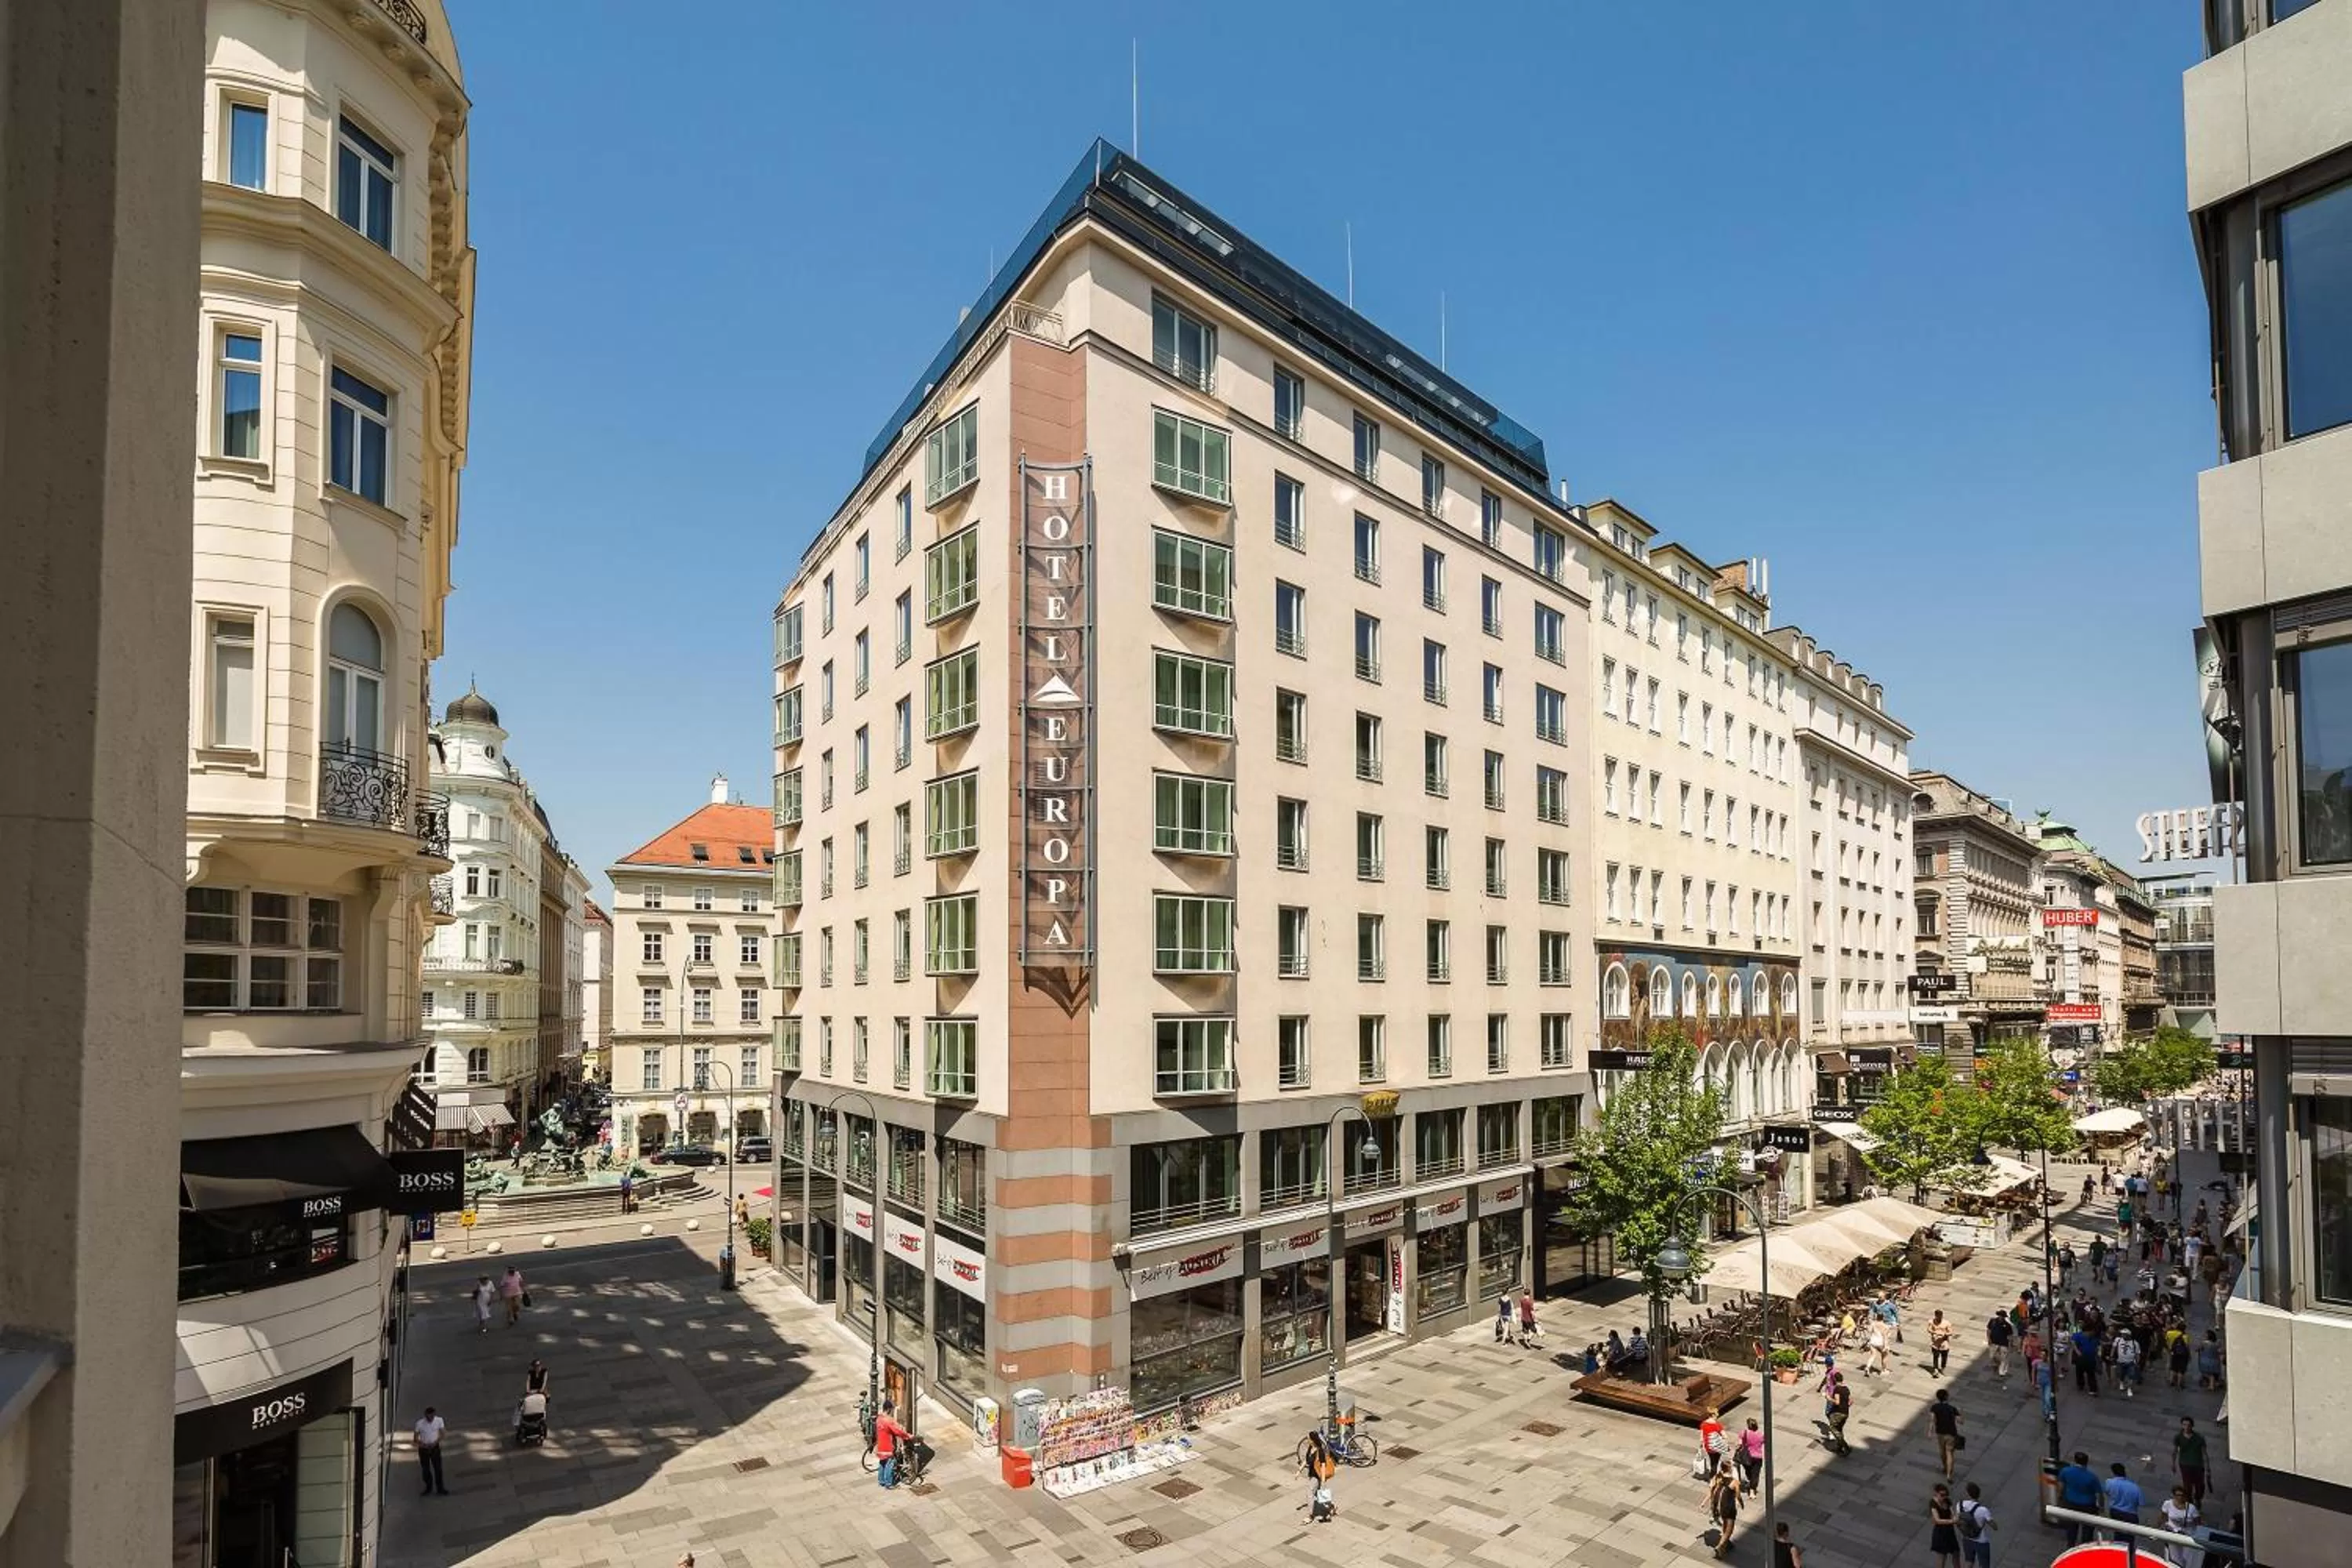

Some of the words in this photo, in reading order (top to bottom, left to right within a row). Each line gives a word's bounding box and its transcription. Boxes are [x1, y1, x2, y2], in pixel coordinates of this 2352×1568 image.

[1042, 475, 1069, 662] HOTEL
[1043, 716, 1069, 945] EUROPA
[2045, 911, 2093, 924] HUBER
[1916, 977, 1948, 986] PAUL
[1813, 1109, 1854, 1120] GEOX
[1768, 1133, 1804, 1144] Jones
[399, 1172, 455, 1188] BOSS
[303, 1196, 342, 1214] BOSS
[252, 1392, 305, 1425] BOSS
